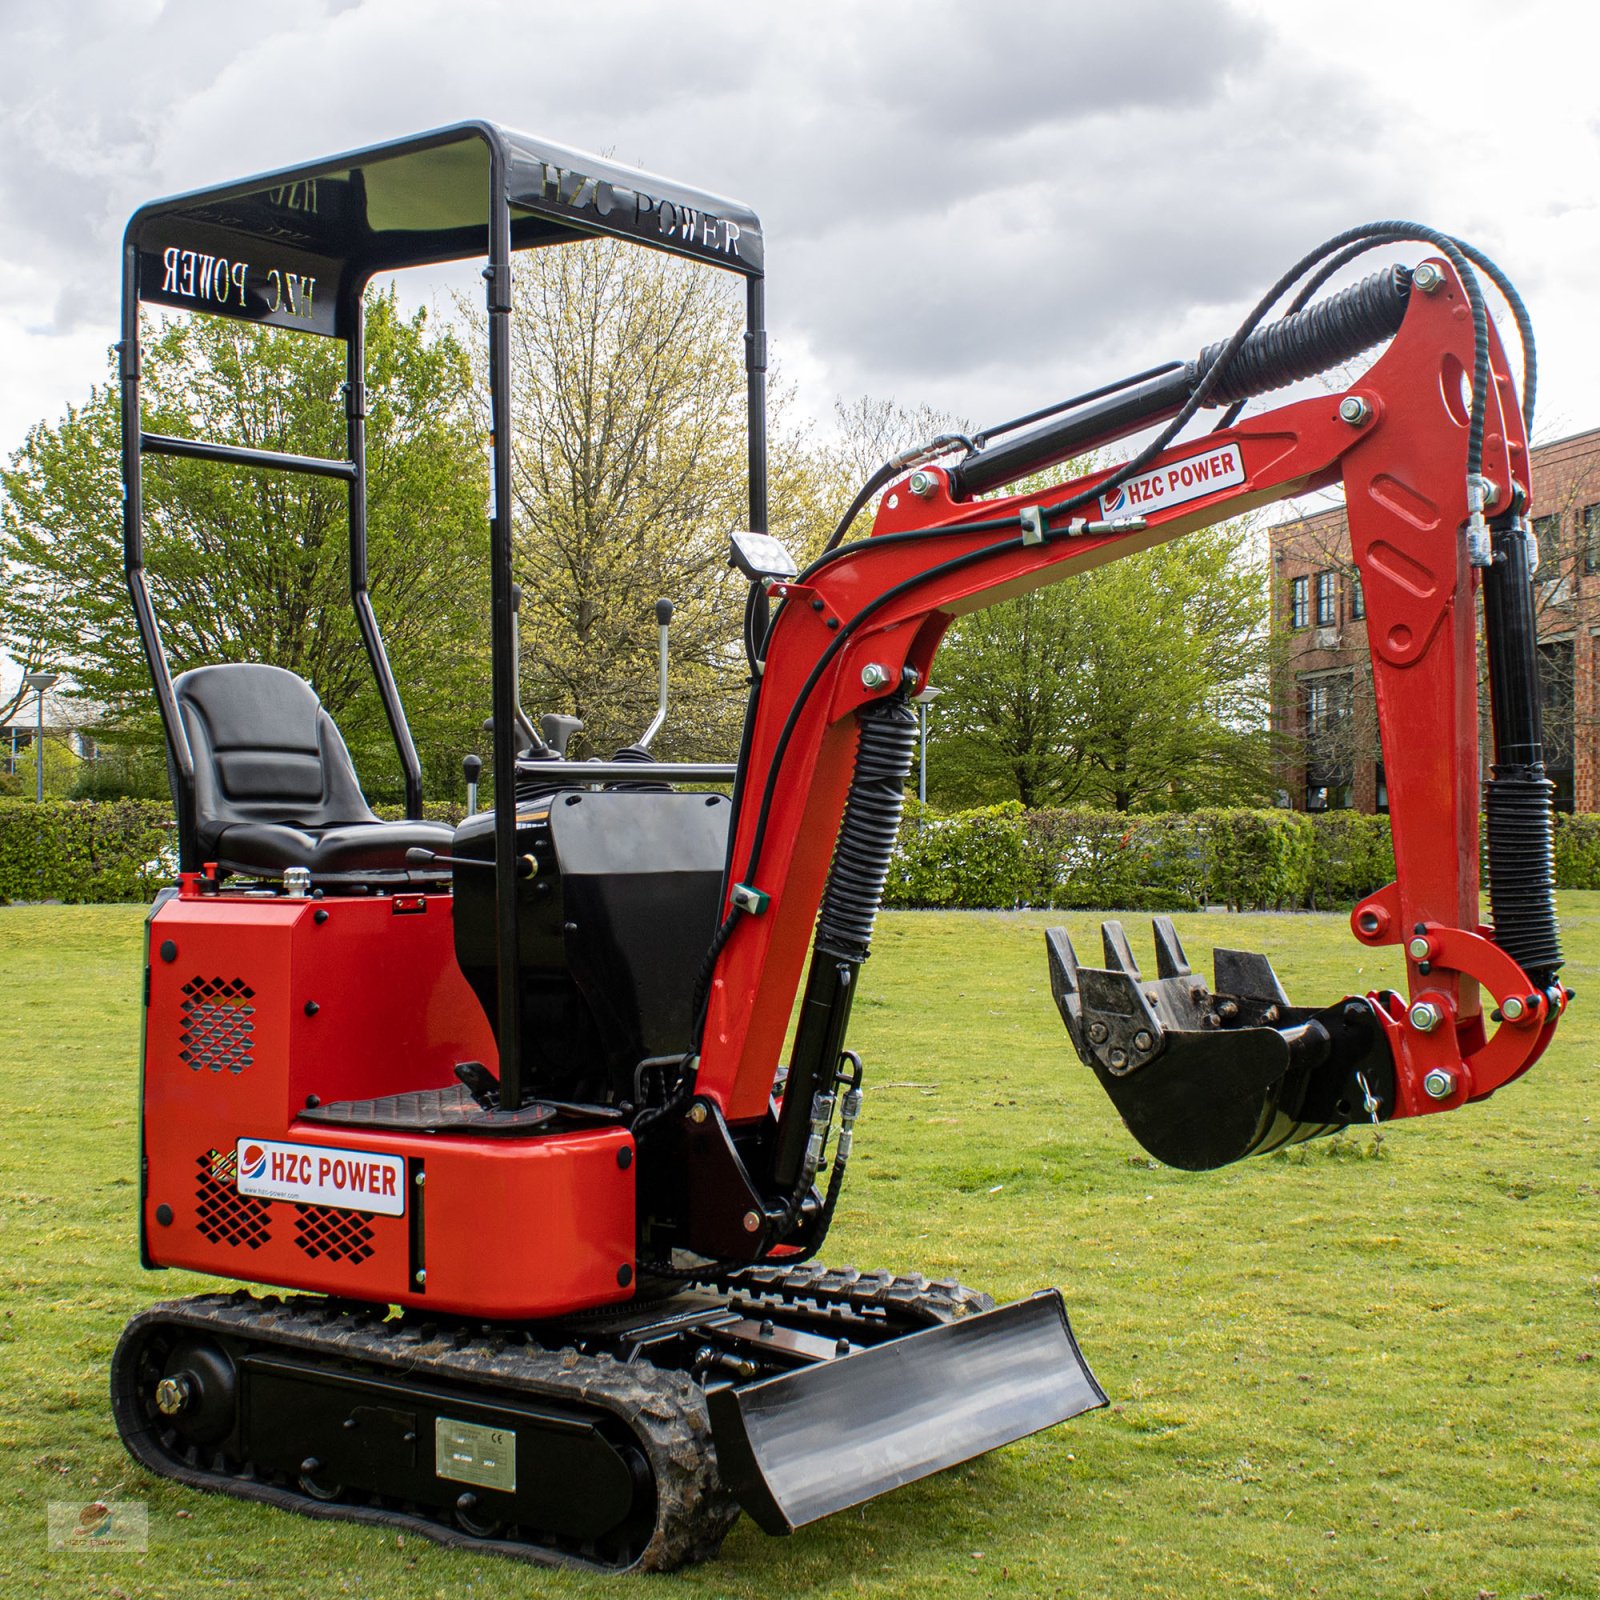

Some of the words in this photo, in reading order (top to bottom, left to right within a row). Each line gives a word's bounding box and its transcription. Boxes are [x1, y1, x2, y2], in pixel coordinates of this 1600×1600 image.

[539, 161, 615, 218] HZC
[632, 190, 742, 257] POWER
[1127, 475, 1165, 506] HZC
[1167, 451, 1236, 492] POWER
[271, 1151, 312, 1186] HZC
[318, 1156, 397, 1197] POWER
